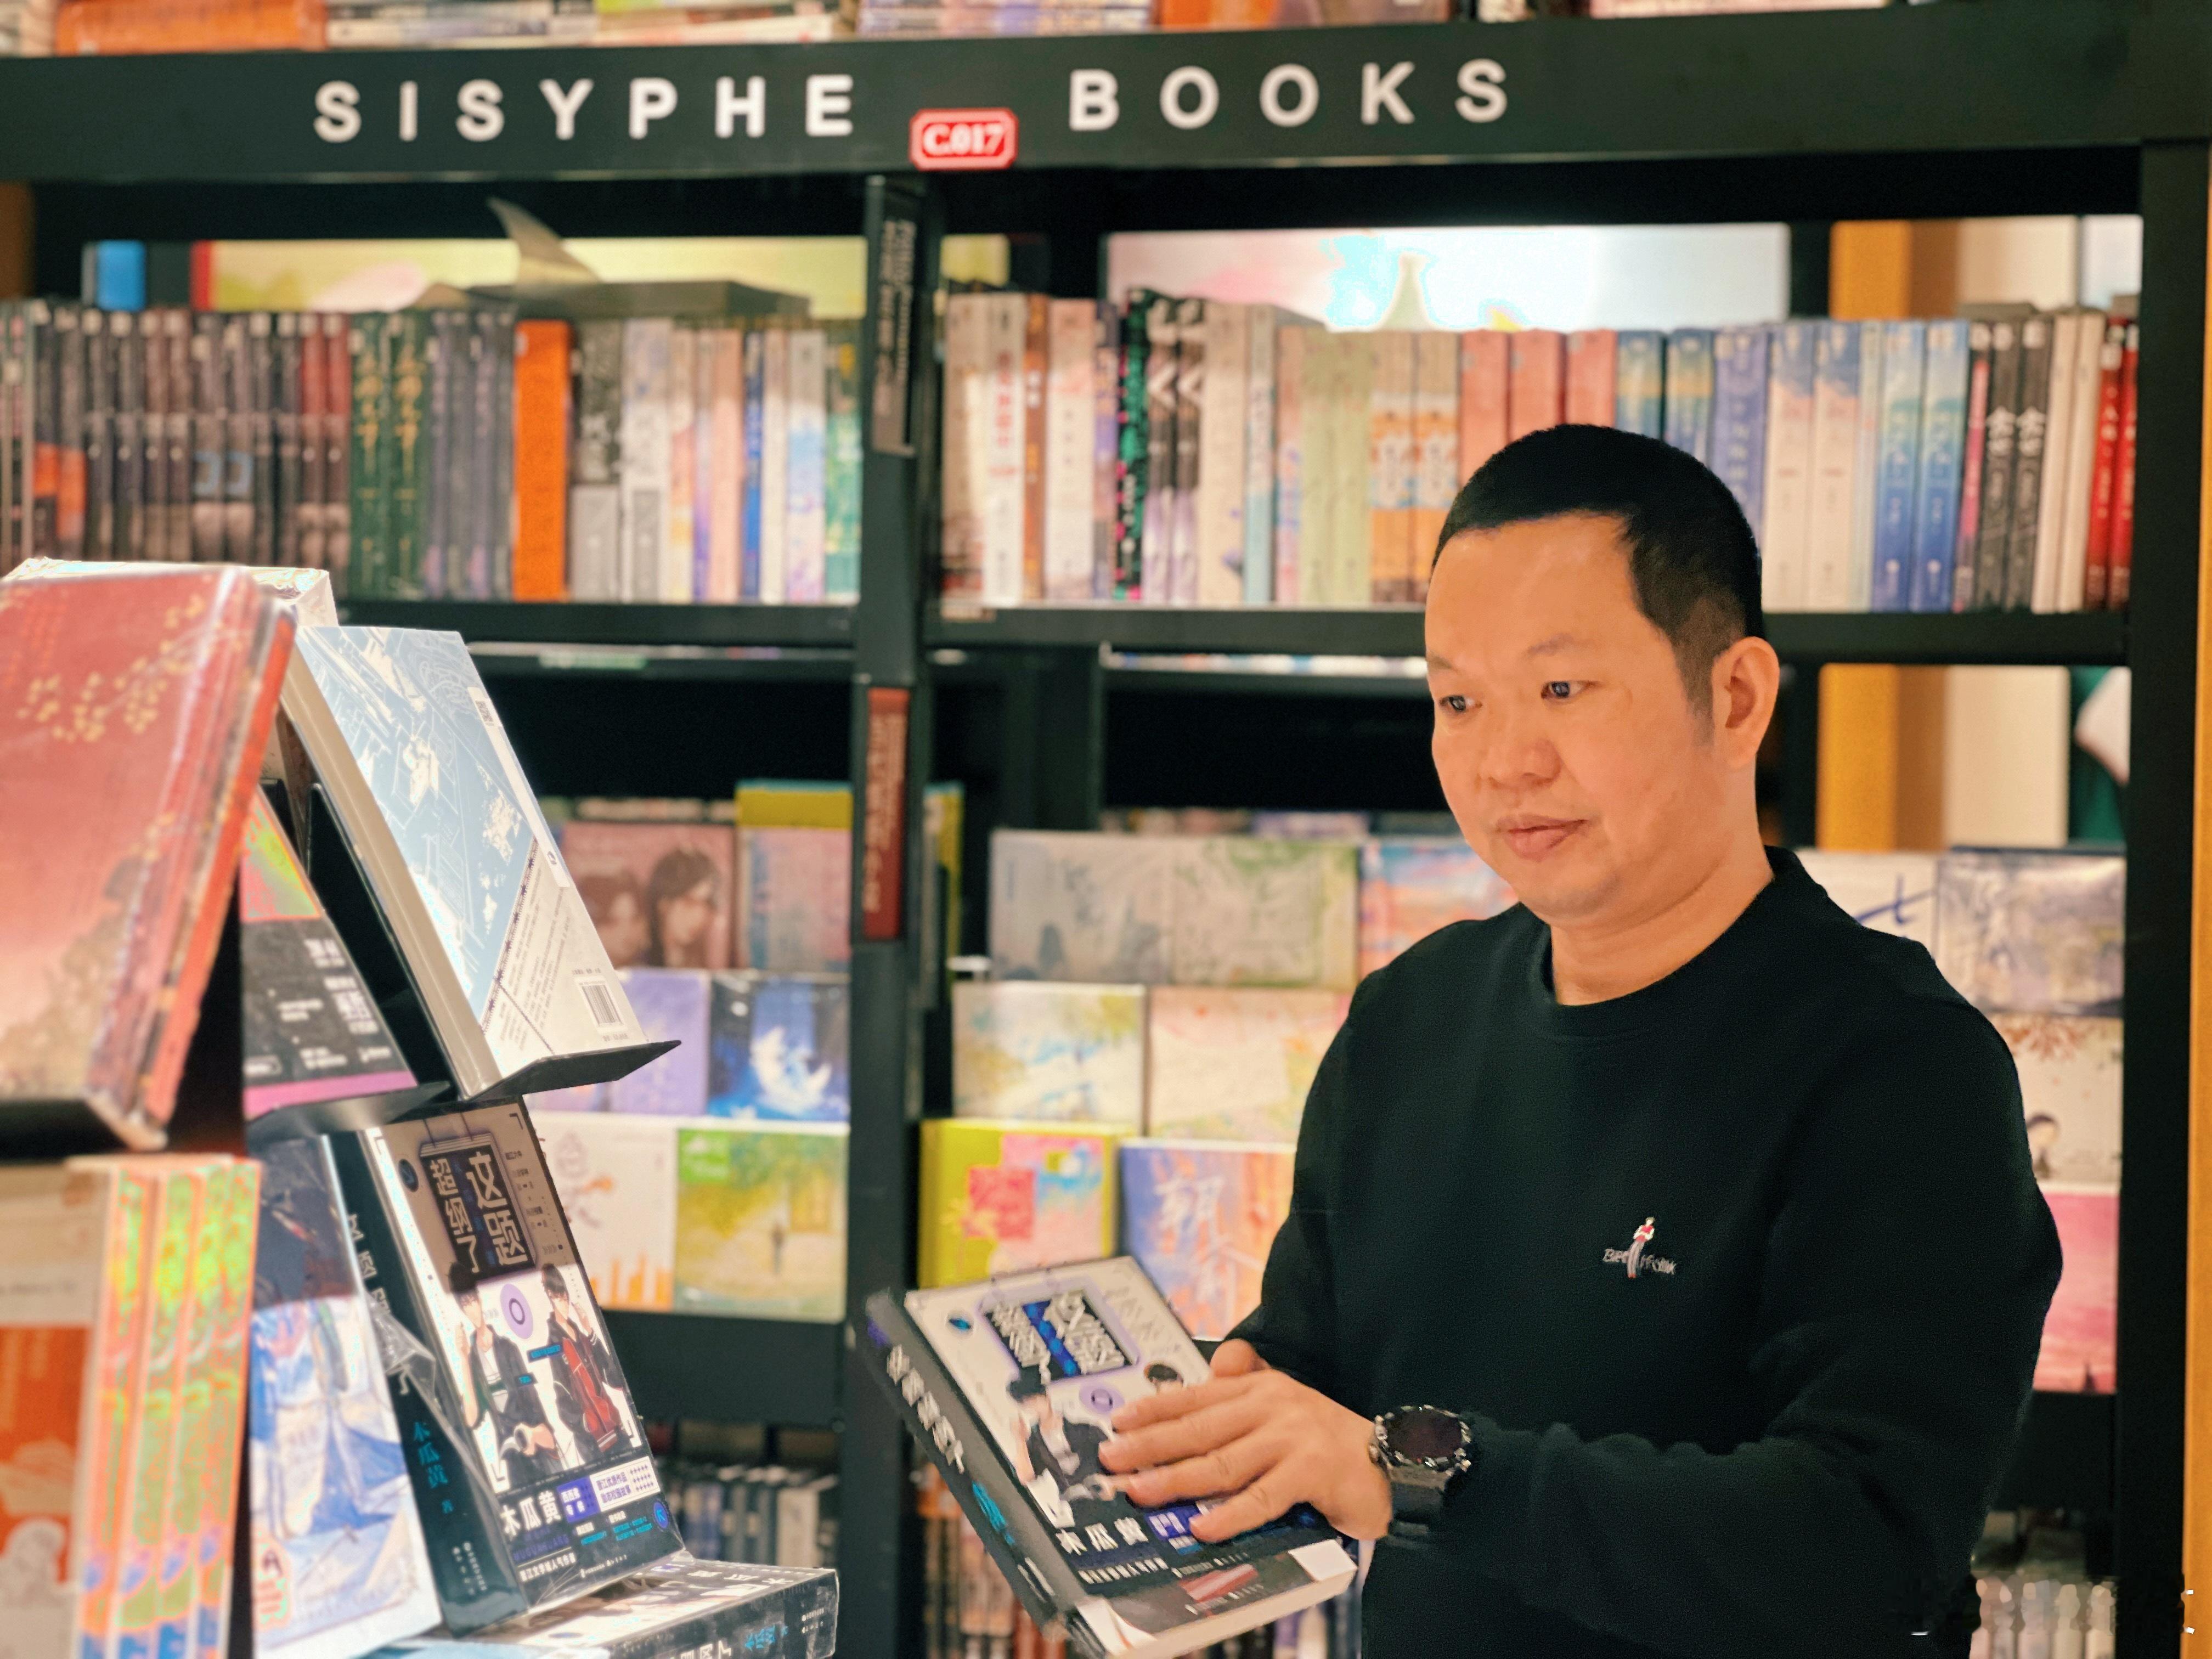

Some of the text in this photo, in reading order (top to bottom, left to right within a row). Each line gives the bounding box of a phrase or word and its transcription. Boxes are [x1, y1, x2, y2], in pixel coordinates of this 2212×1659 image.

[315, 60, 1505, 141] SISYPHE BOOKS
[430, 1158, 480, 1273] 超纲了
[465, 1151, 529, 1266] 这题
[414, 1422, 448, 1488] 木瓜黄
[500, 1490, 561, 1541] 木瓜黄
